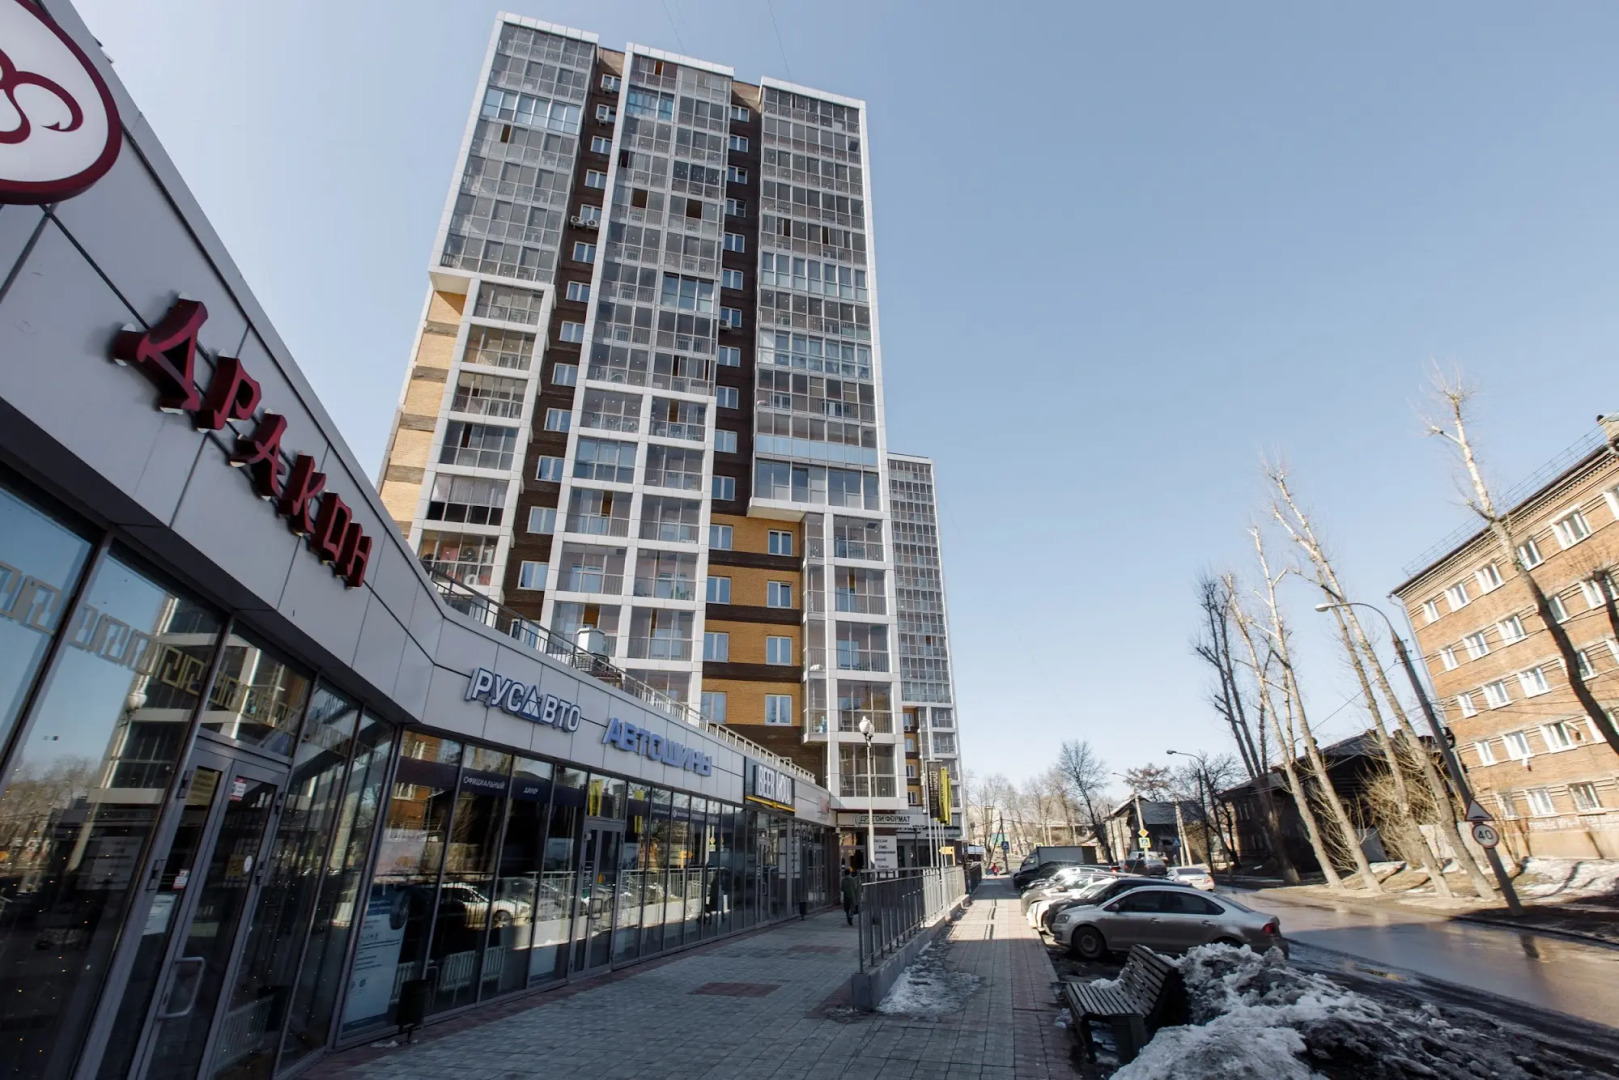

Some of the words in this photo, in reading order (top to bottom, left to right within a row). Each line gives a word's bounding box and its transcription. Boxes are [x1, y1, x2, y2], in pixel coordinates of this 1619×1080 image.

[113, 298, 372, 589] ДРАКОН
[465, 668, 582, 732] РУСАВТО
[602, 717, 712, 777] АВТОШИНЫ
[463, 776, 506, 790] ОФИЦИАЛЬНЫЙ
[758, 765, 775, 800] BEER
[885, 815, 911, 823] ФОРМАТ
[1477, 829, 1494, 841] 40
